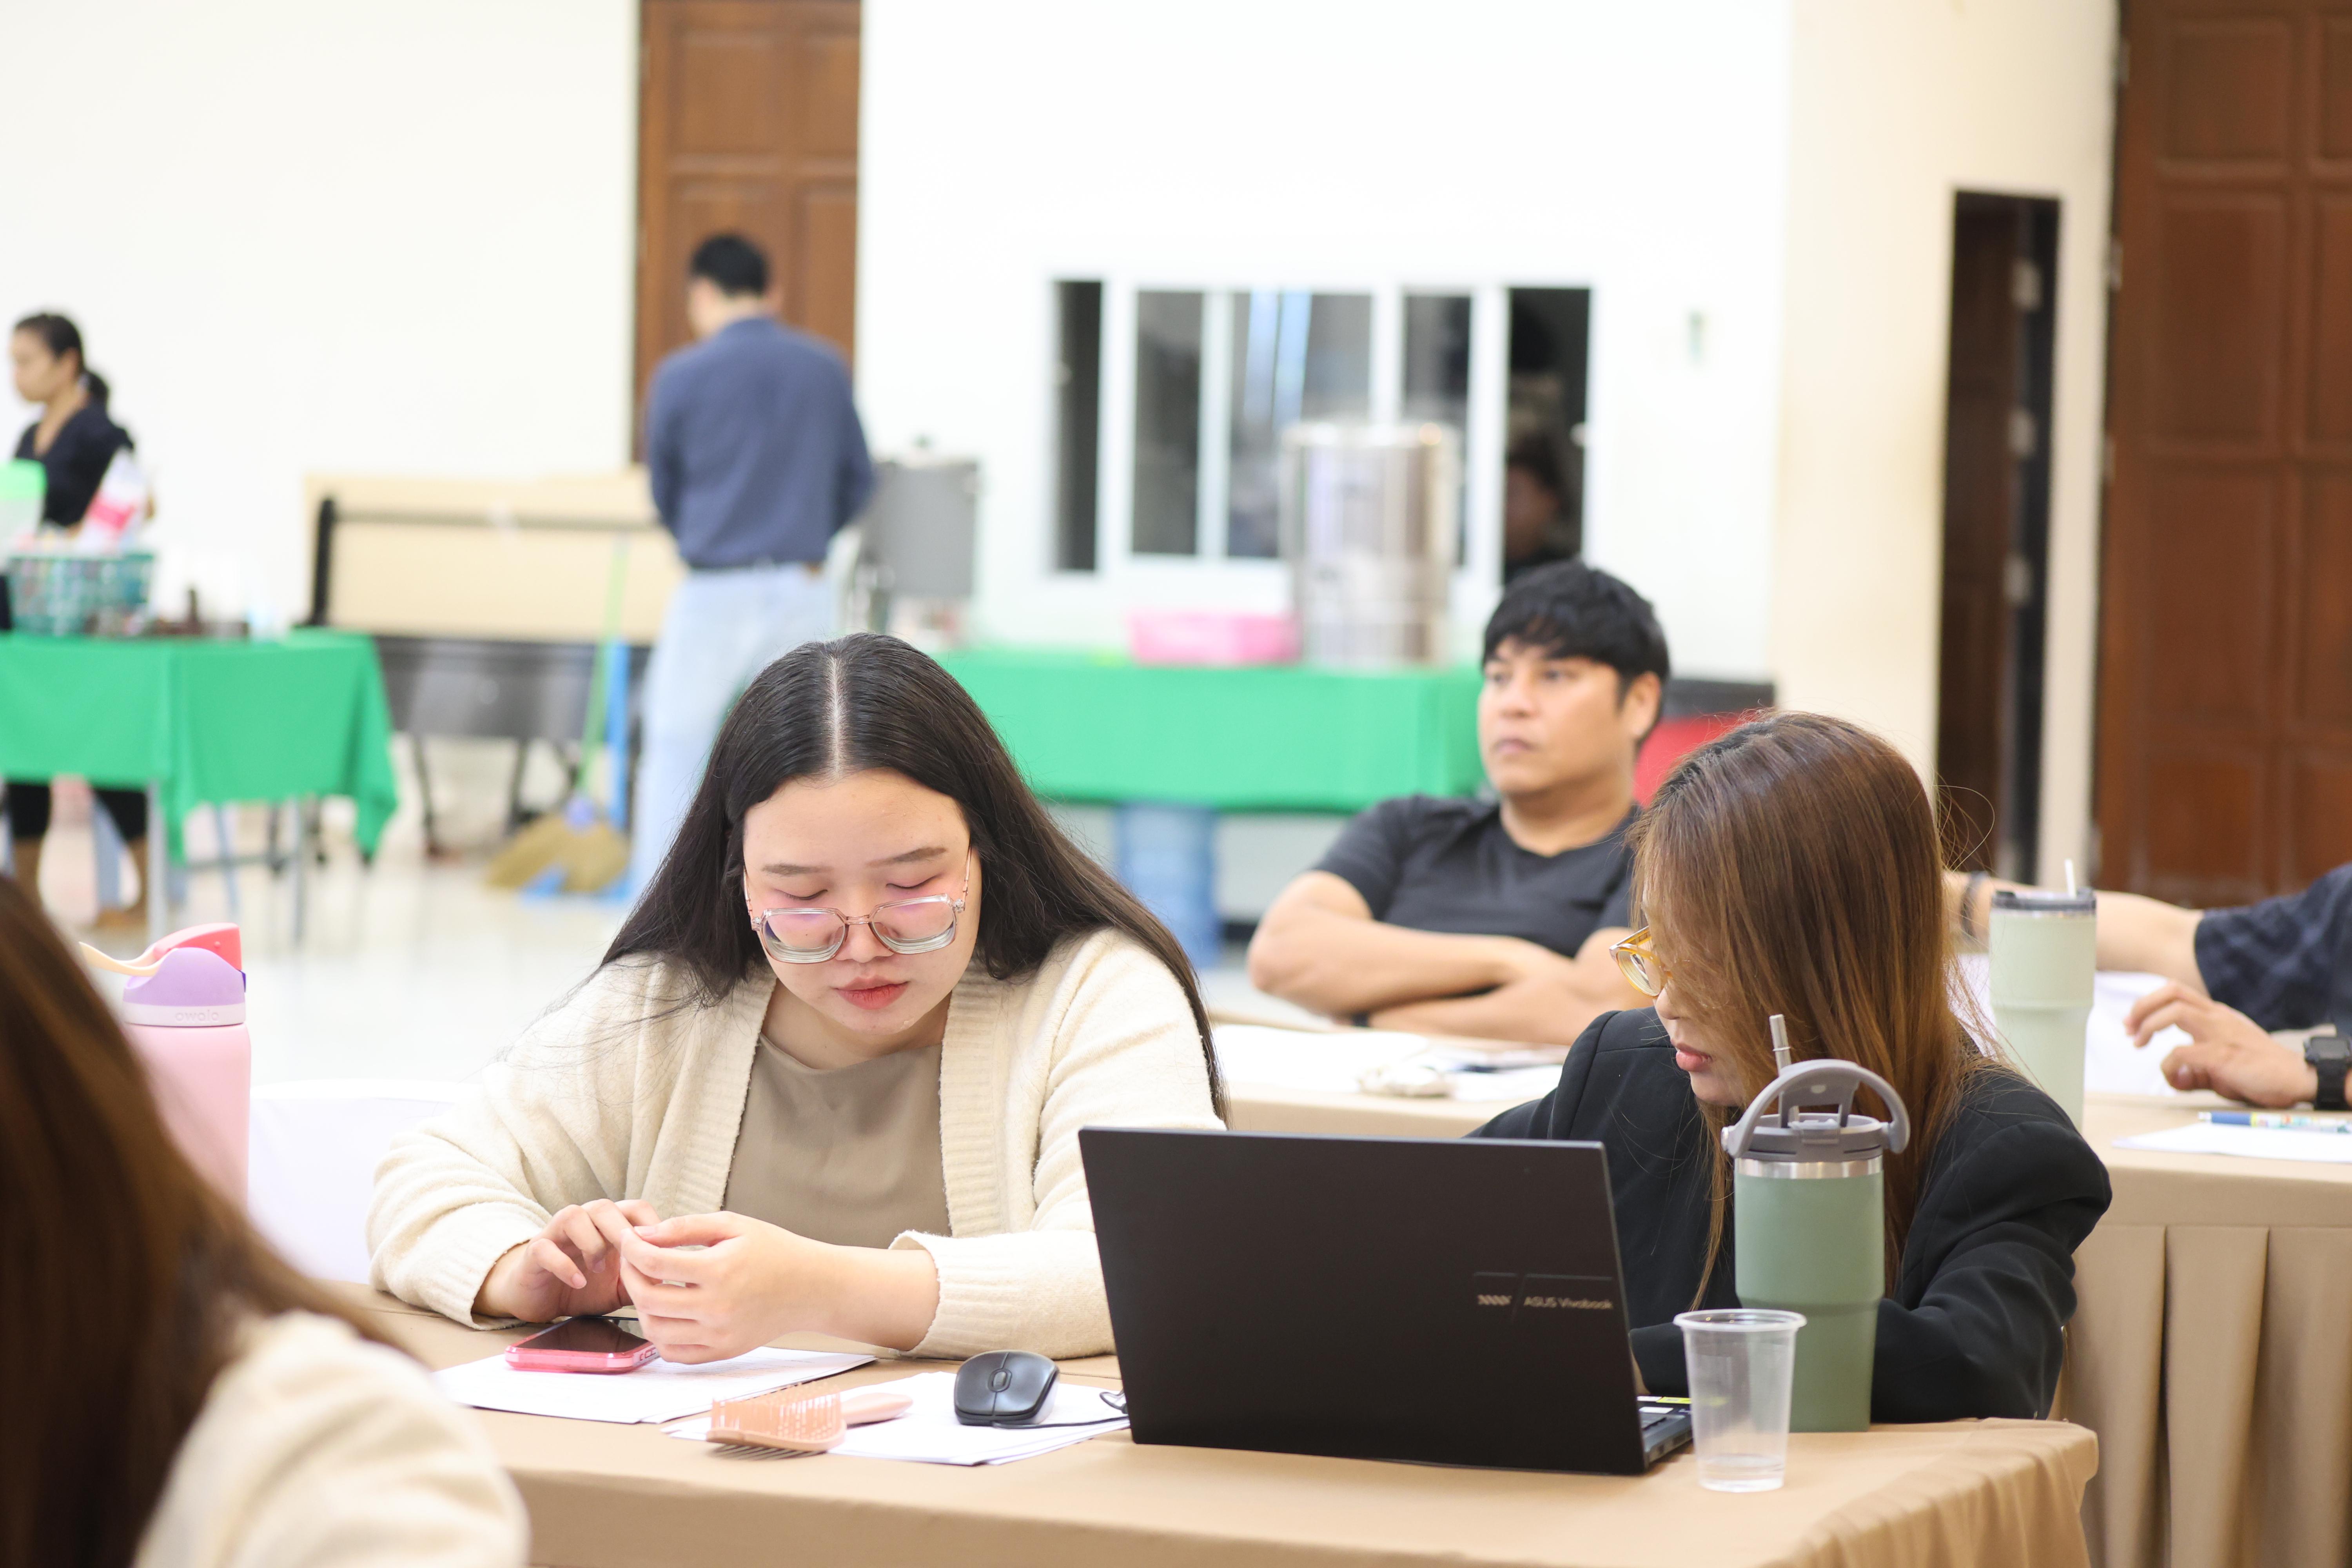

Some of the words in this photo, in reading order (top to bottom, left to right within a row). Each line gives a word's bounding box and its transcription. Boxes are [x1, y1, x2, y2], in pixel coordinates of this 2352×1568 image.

[175, 1009, 219, 1022] owala
[1524, 1296, 1557, 1308] ASUS
[1558, 1298, 1613, 1309] Vivobook
